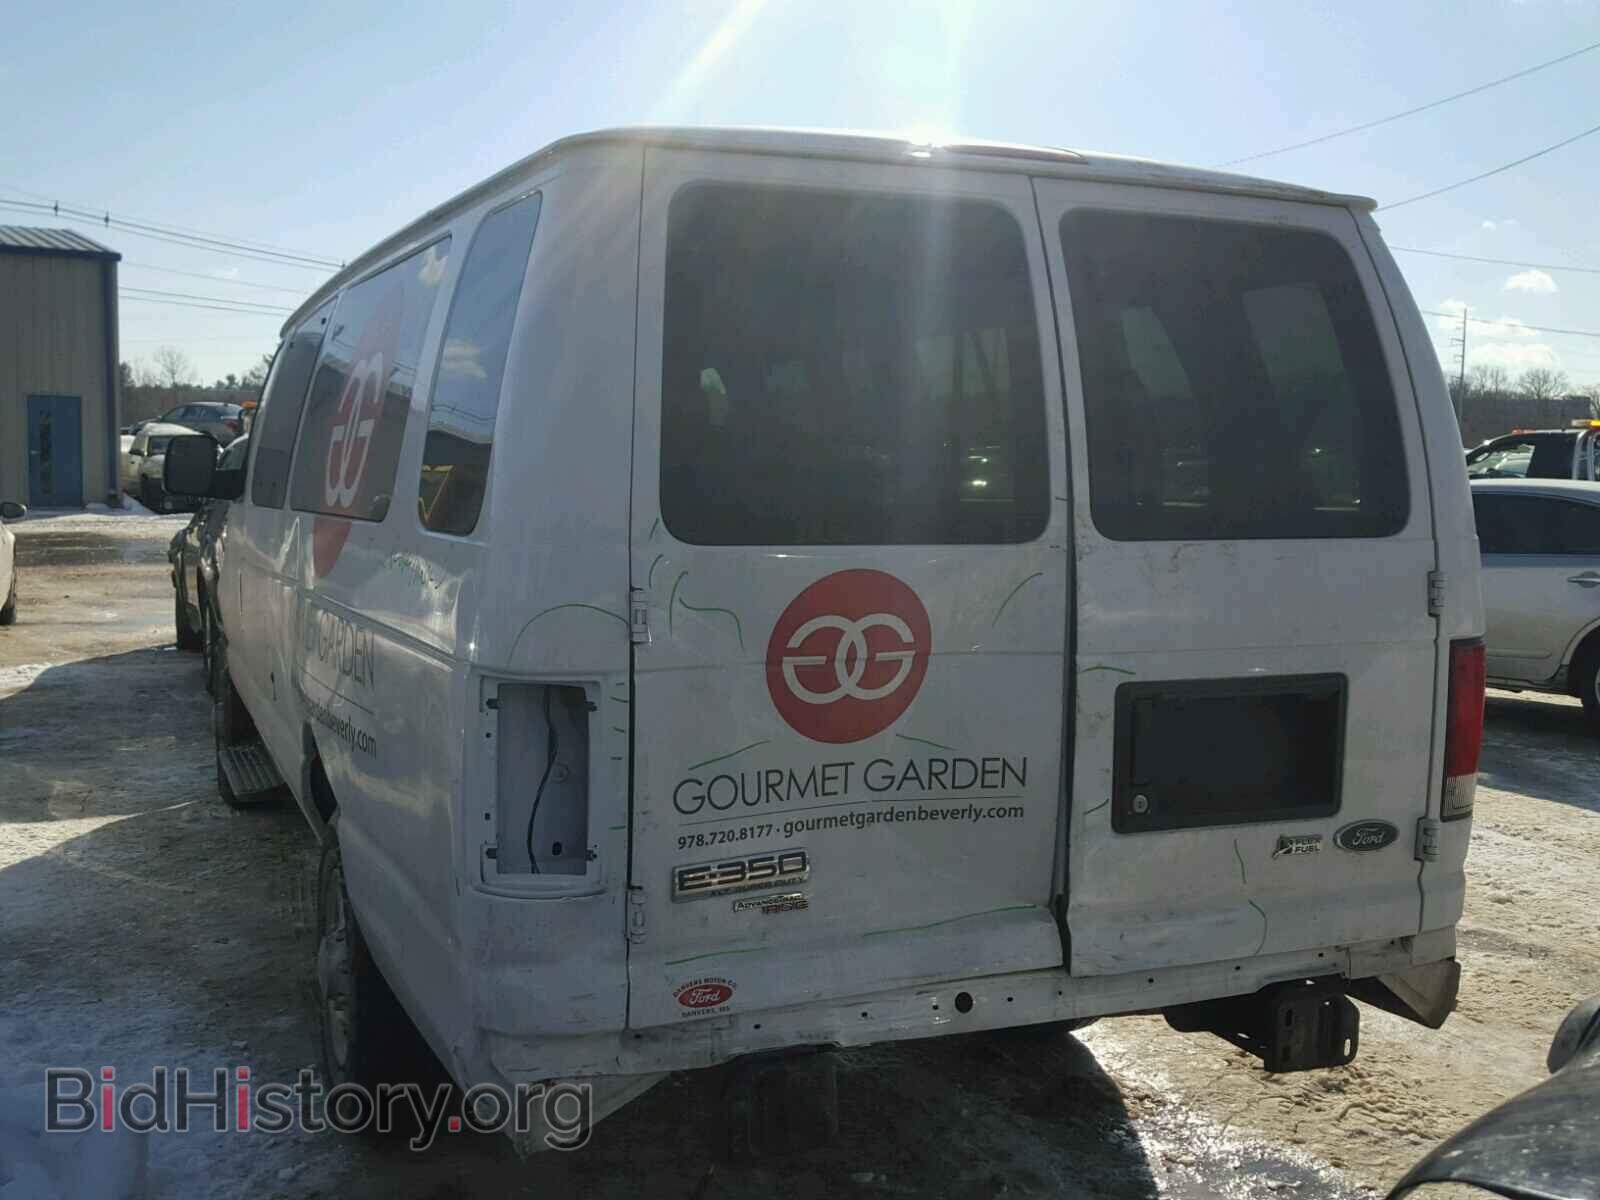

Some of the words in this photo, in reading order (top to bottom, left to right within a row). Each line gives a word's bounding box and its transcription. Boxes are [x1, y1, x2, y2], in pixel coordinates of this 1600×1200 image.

[673, 762, 855, 815] GOURMET
[864, 757, 1028, 792] GARDEN
[678, 824, 773, 850] 978.720.8177
[783, 804, 1024, 838] gourmetgardenbeverly.com
[688, 987, 721, 1005] Ford
